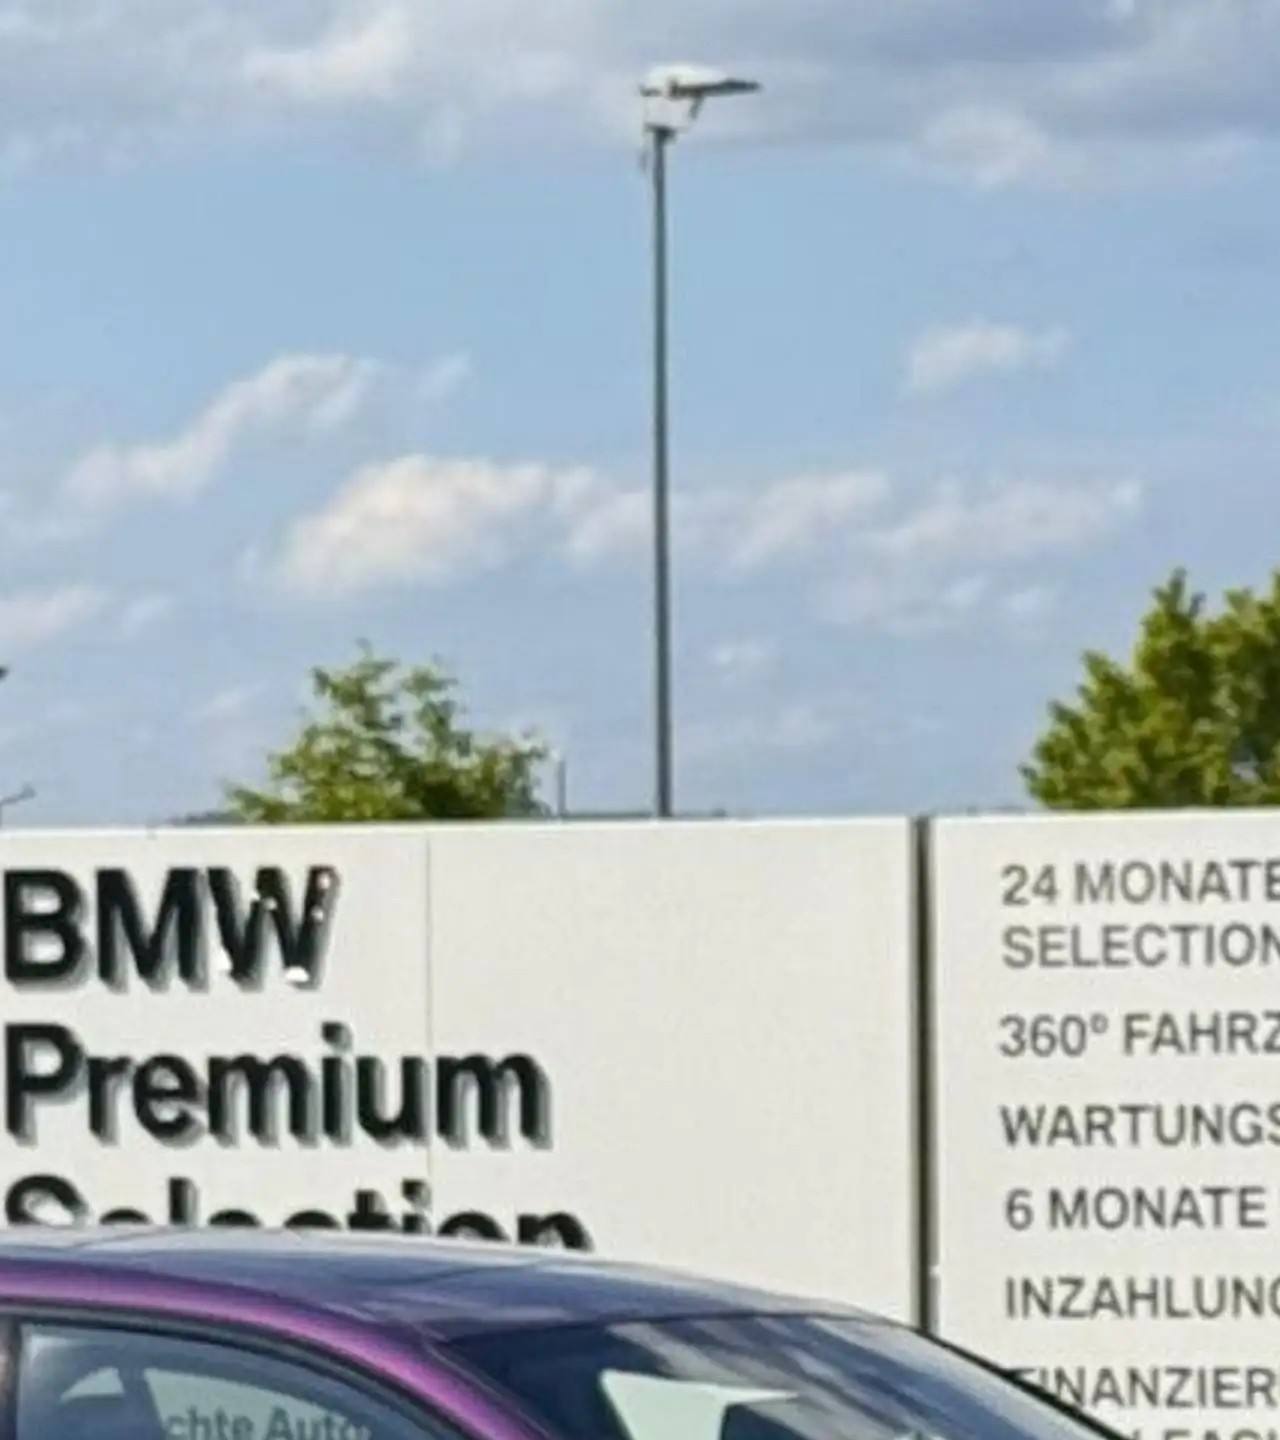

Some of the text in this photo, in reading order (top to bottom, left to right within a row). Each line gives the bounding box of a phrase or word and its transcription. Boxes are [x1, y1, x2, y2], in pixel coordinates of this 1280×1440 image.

[1003, 864, 1057, 906] 24
[3, 866, 339, 990] BMW
[5, 1022, 551, 1148] Premium
[1005, 1188, 1034, 1231] 6
[1048, 1186, 1267, 1230] MONATE
